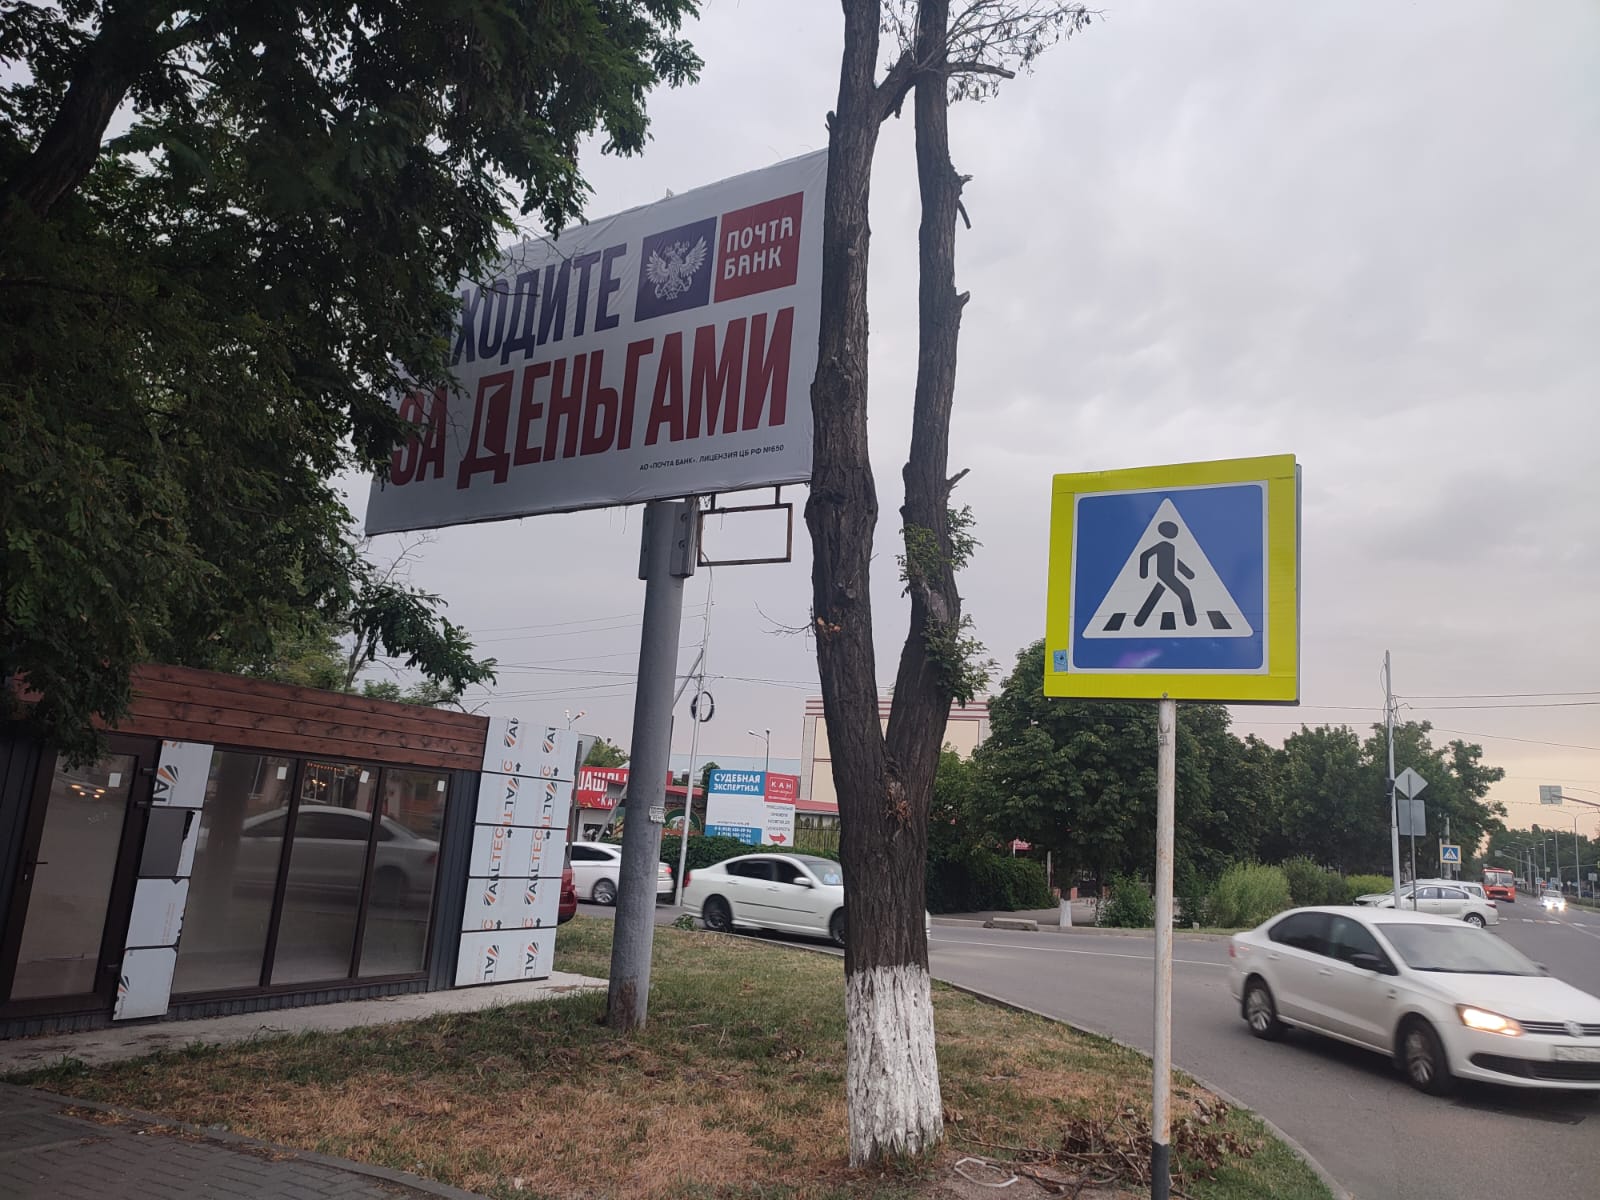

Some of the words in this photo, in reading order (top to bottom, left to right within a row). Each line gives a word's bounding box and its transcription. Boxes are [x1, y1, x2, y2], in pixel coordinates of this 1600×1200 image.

[725, 216, 794, 253] ПОЧТА
[723, 247, 783, 280] БАНК
[443, 243, 628, 367] ХОДИТЕ
[457, 306, 794, 489] ДЕНЬГАМИ
[699, 450, 738, 462] ЛИЦЕНЗИЯ
[739, 448, 750, 457] ЦБ
[750, 446, 762, 455] РФ
[713, 773, 761, 784] СУДЕБНАЯ
[713, 783, 760, 792] ЭКСПЕРТИЗА
